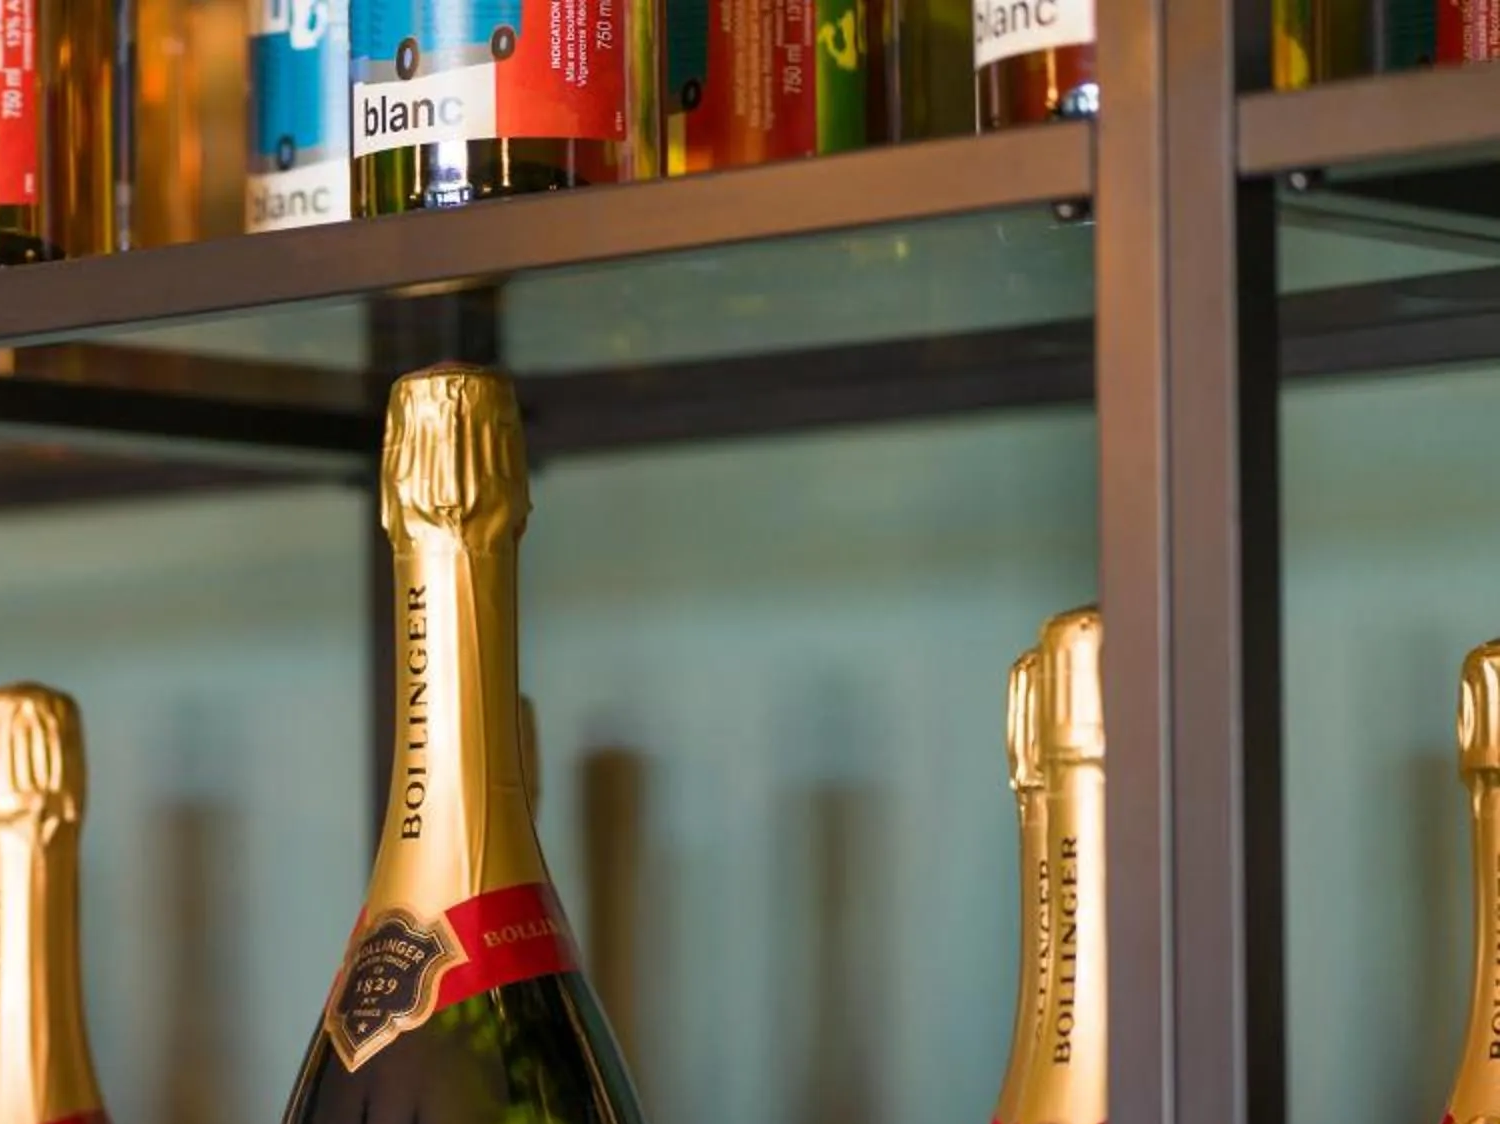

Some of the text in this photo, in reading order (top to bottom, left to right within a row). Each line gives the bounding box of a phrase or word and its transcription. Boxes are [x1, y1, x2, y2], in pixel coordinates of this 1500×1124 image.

[596, 20, 612, 50] 750
[364, 96, 464, 137] blanc
[401, 583, 428, 840] BOLLINGER
[1053, 836, 1078, 1065] BOLLINGER
[356, 977, 398, 995] 1829
